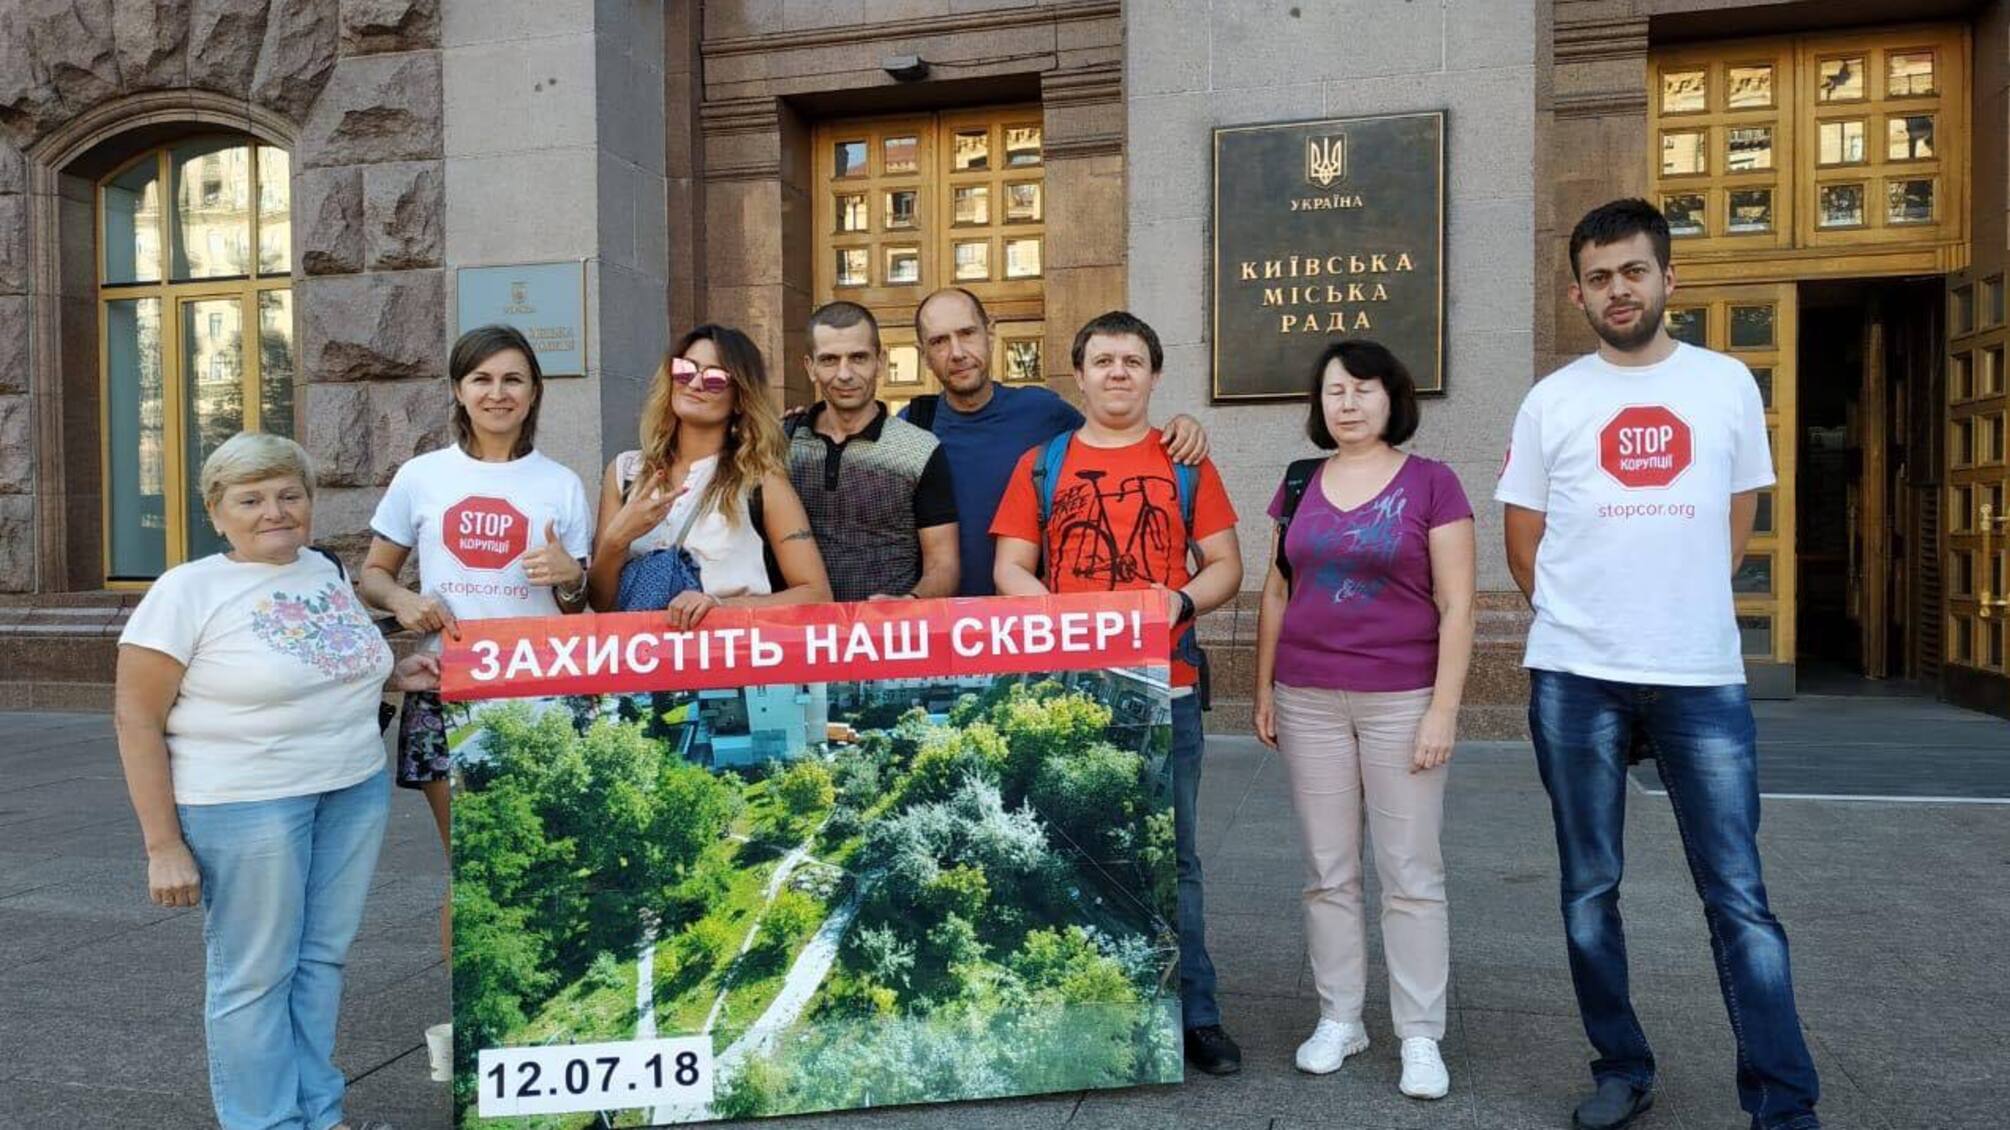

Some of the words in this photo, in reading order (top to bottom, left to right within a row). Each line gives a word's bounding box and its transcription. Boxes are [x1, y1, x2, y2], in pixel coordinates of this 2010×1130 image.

[1290, 194, 1363, 212] УКРАЇНА
[1240, 253, 1414, 280] КИЇВСЬКА
[1262, 284, 1390, 306] МІСЬКА
[1281, 311, 1371, 333] РАДА
[1619, 425, 1673, 455] STOP
[1620, 455, 1673, 471] КОРУПЦІЇ
[1598, 502, 1696, 520] stopcor.org
[459, 511, 513, 537] STOP
[459, 537, 510, 554] КОРУПЦІЇ
[440, 581, 529, 600] stopcor.org
[470, 627, 784, 682] ЗАХИСТІТЬ
[805, 620, 929, 665] НАШ
[952, 609, 1142, 657] СКВЕР!
[487, 1051, 700, 1099] 12.07.18
